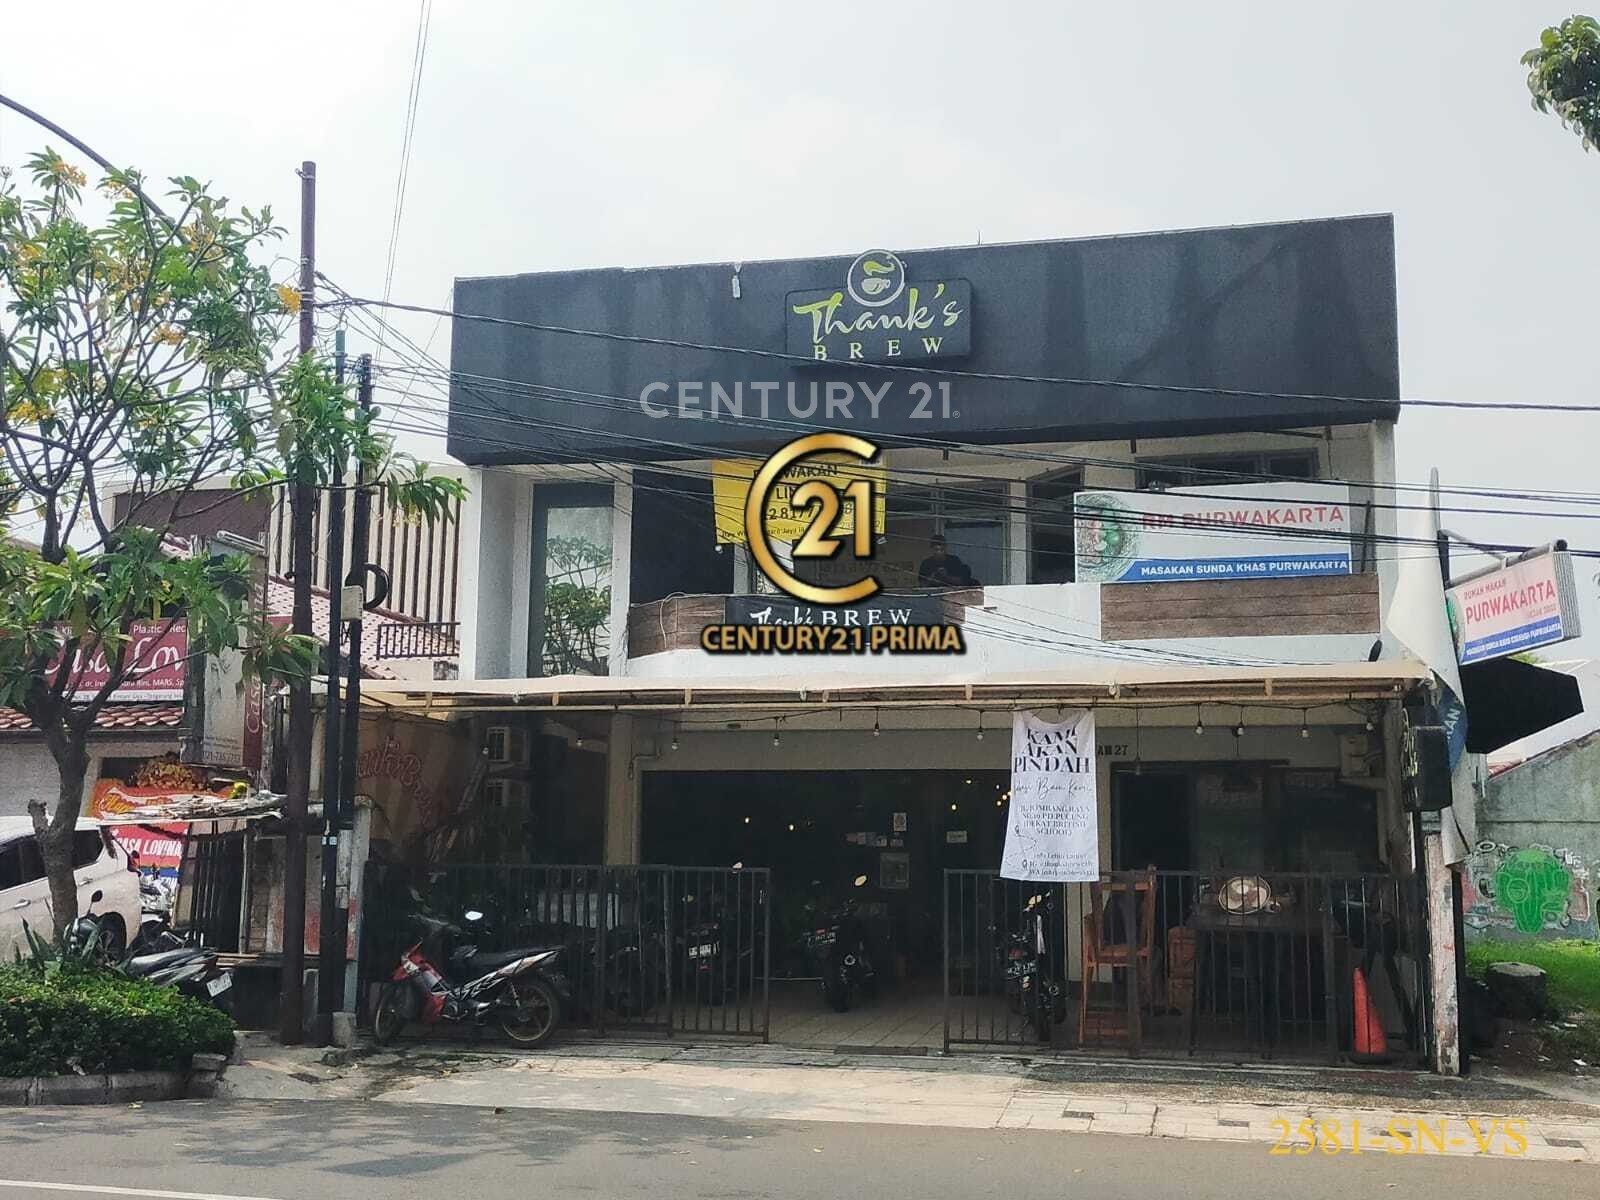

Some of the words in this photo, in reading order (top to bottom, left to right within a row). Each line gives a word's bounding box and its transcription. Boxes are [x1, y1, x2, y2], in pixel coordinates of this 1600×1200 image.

[793, 283, 964, 344] Thank's
[814, 337, 943, 361] BREW
[1141, 565, 1194, 576] MASAKAN
[1197, 564, 1234, 575] SUNDA
[1236, 562, 1267, 573] KHAS
[1269, 560, 1347, 572] PURWAKARTA
[1465, 579, 1556, 625] PURWAKARTA
[821, 608, 912, 626] BREW
[1021, 740, 1077, 758] AKAN
[1014, 756, 1089, 774] PINDAH
